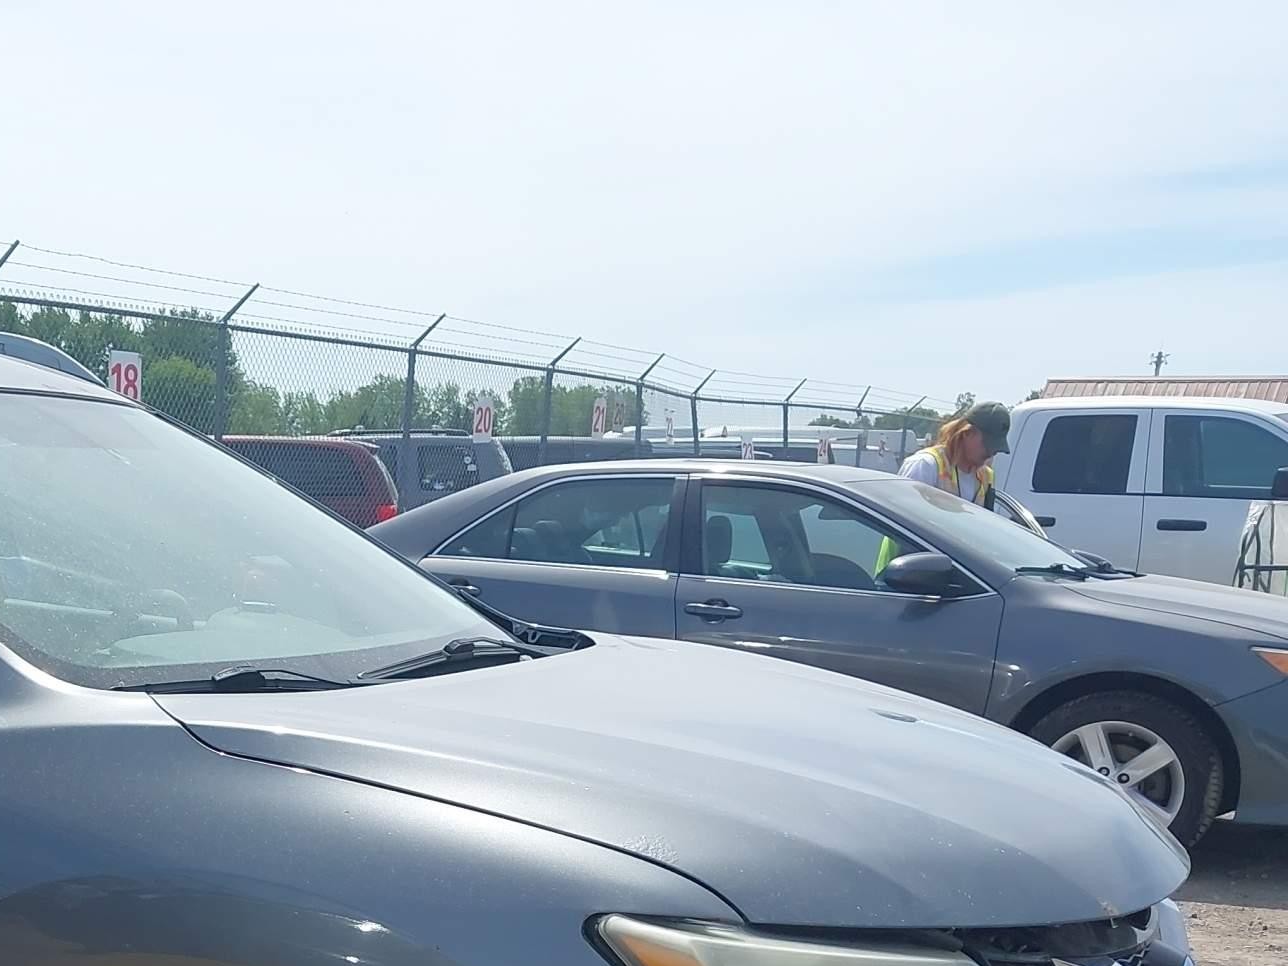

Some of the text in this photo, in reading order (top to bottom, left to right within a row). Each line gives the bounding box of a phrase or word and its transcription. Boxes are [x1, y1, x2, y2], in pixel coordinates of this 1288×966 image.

[111, 363, 138, 399] 18
[475, 406, 492, 433] 20
[593, 405, 606, 433] 21
